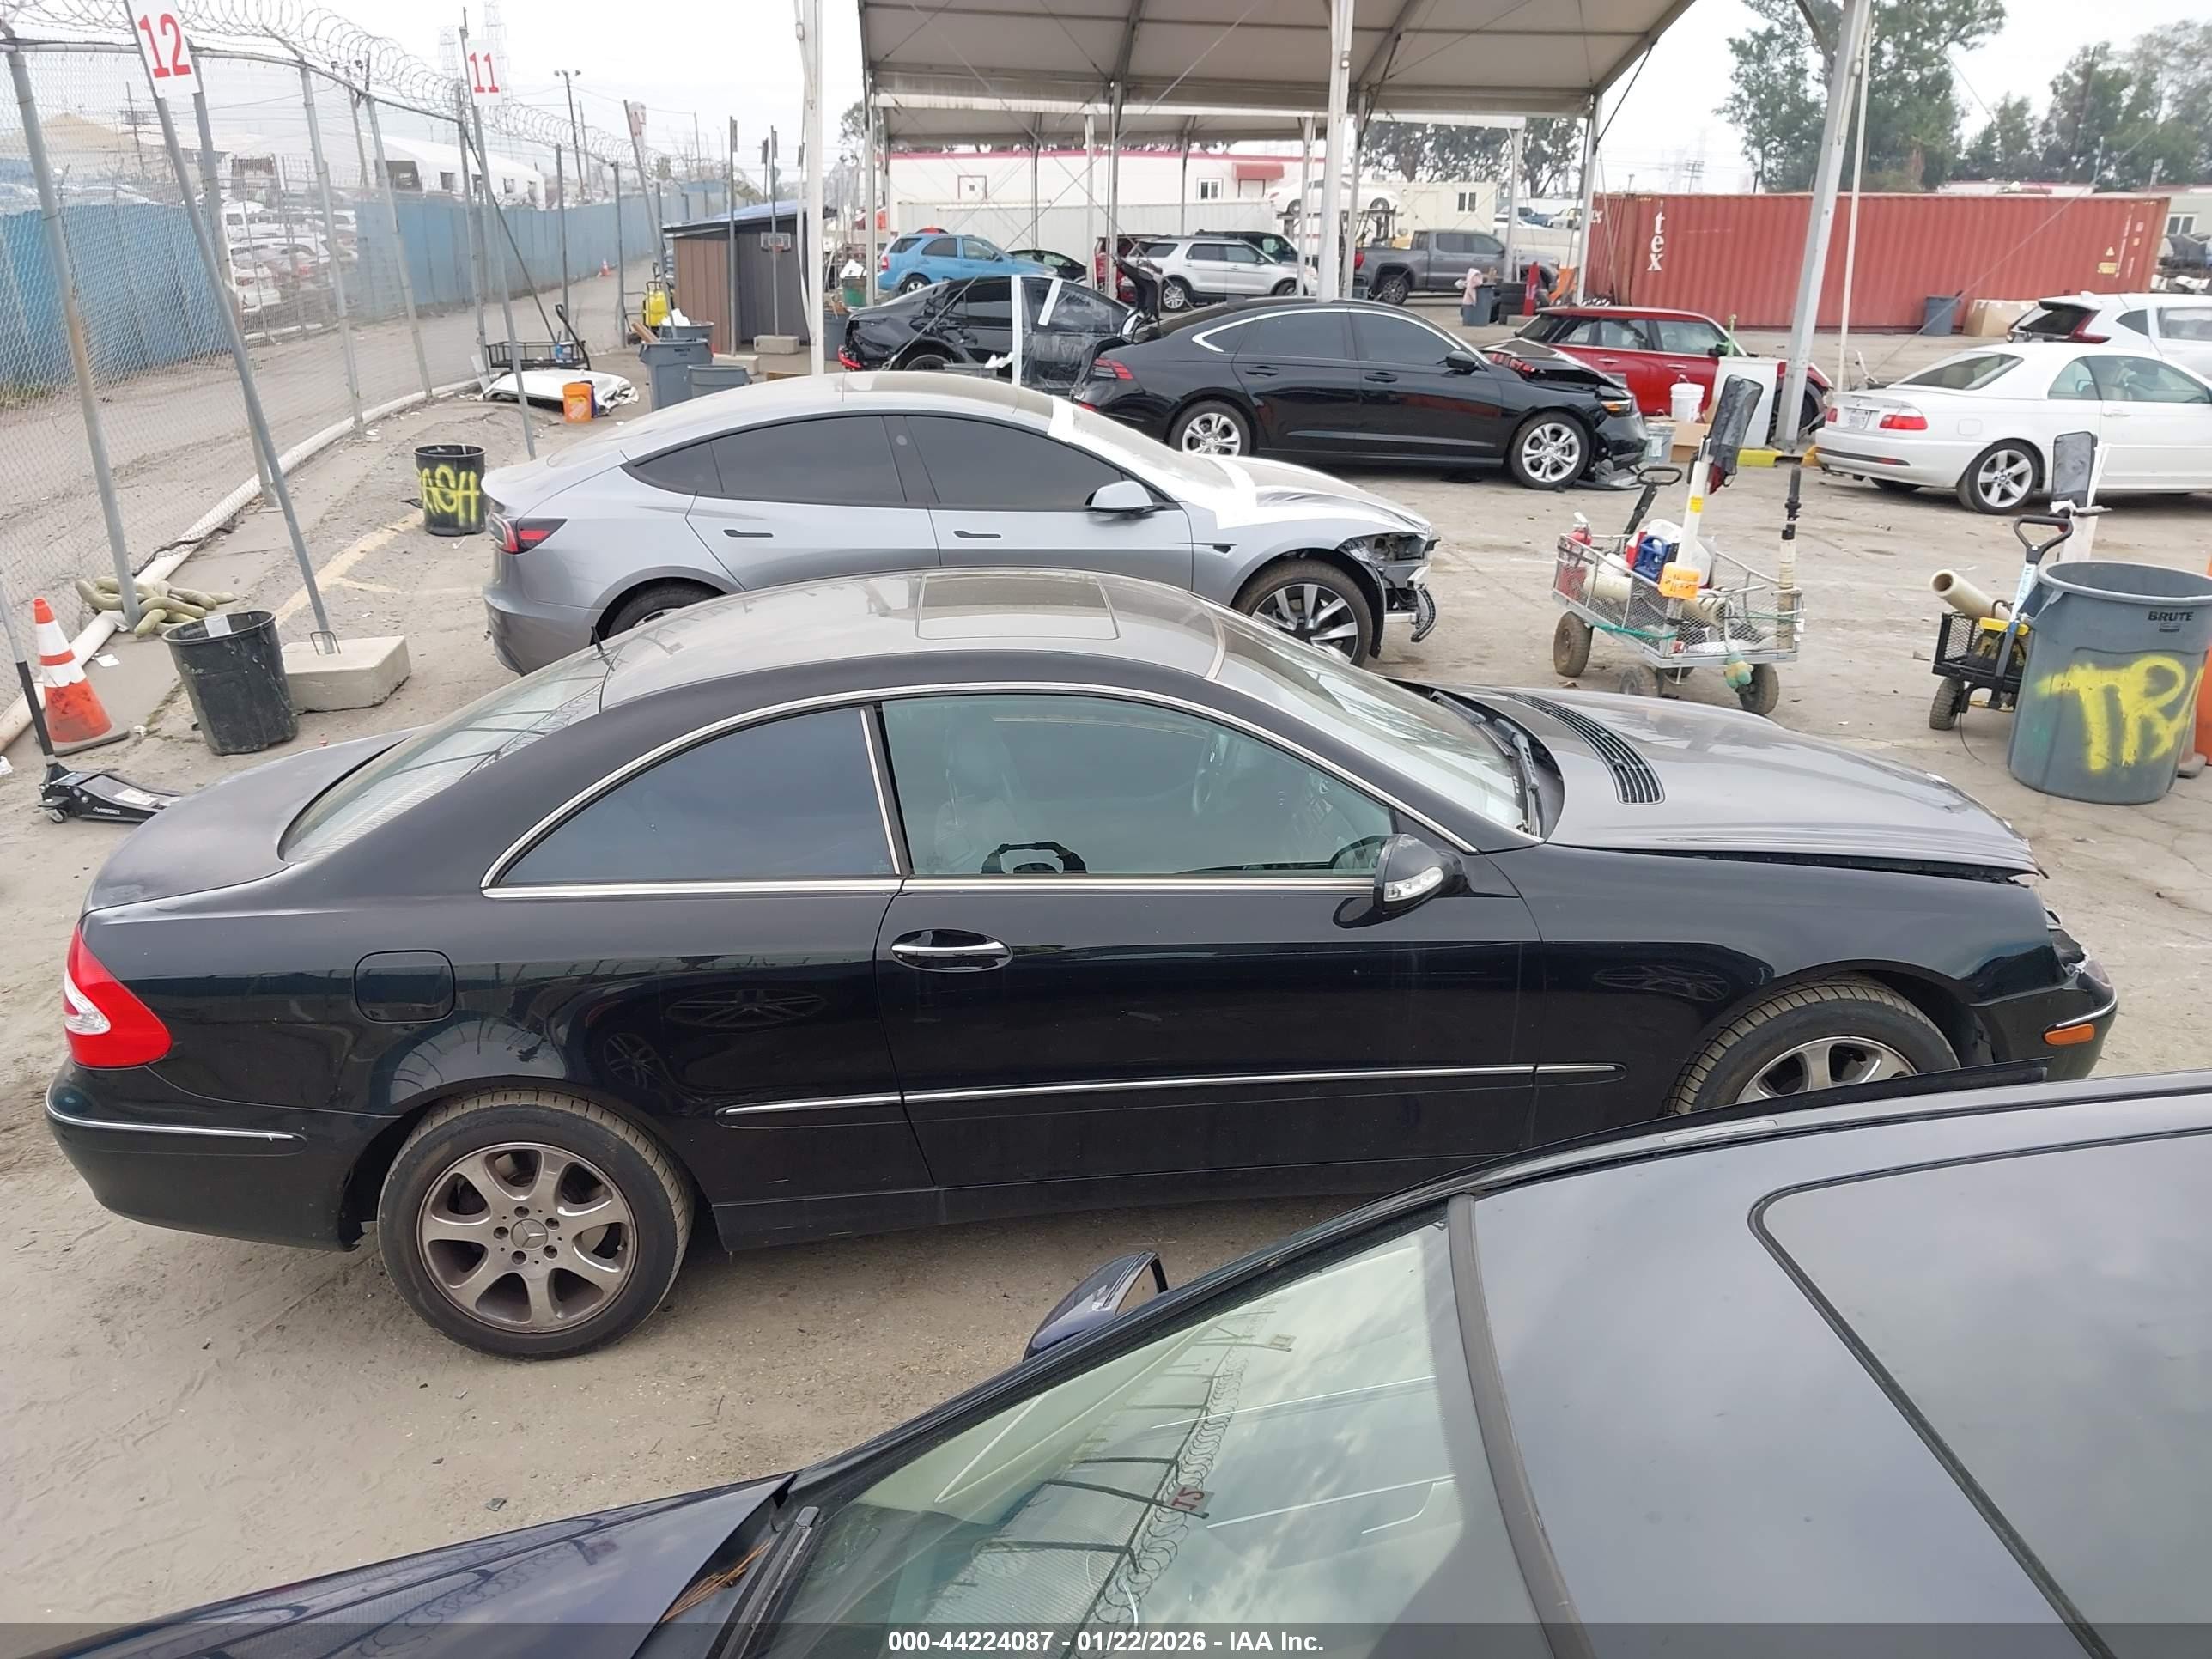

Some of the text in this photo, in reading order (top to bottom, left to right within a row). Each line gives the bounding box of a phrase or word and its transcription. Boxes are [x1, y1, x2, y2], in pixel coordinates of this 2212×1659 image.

[138, 13, 191, 78] 12
[469, 52, 499, 93] 11
[1646, 211, 1665, 271] tex
[2148, 611, 2194, 622] BRUTE
[2033, 655, 2203, 770] TR
